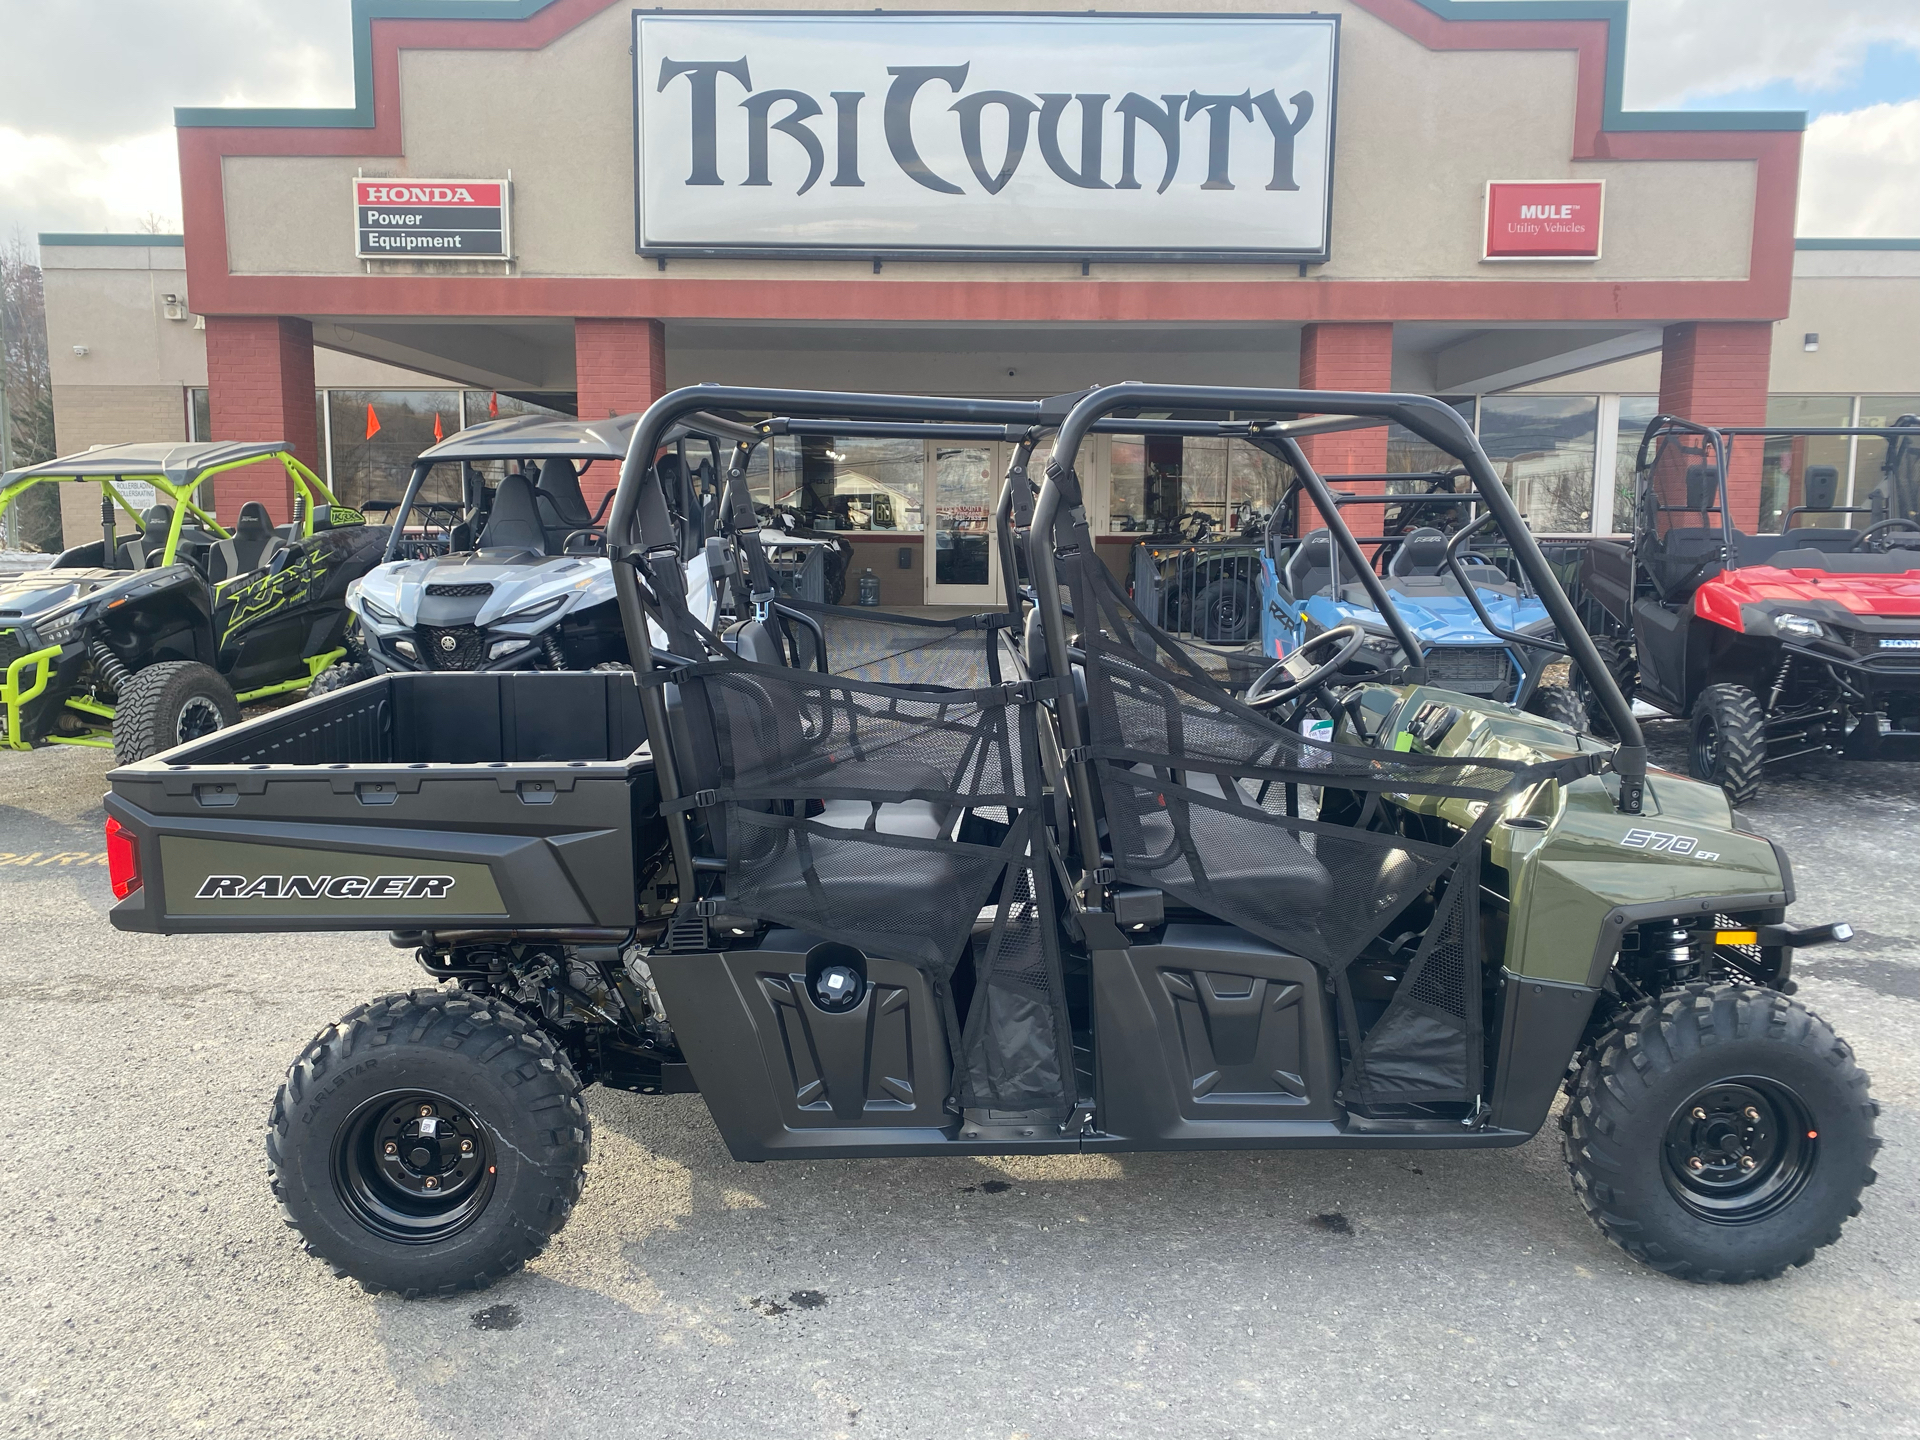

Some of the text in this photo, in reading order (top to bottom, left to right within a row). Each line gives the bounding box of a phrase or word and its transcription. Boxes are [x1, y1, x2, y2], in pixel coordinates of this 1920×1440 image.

[366, 187, 475, 202] HONDA
[367, 210, 423, 225] Power
[1507, 222, 1586, 236] Utility Vehicles
[368, 232, 462, 250] Equipment
[1269, 599, 1296, 636] RZR
[1620, 827, 1721, 862] 570 EFI
[194, 874, 456, 900] RANGER
[301, 1058, 379, 1125] CARLSTAR
